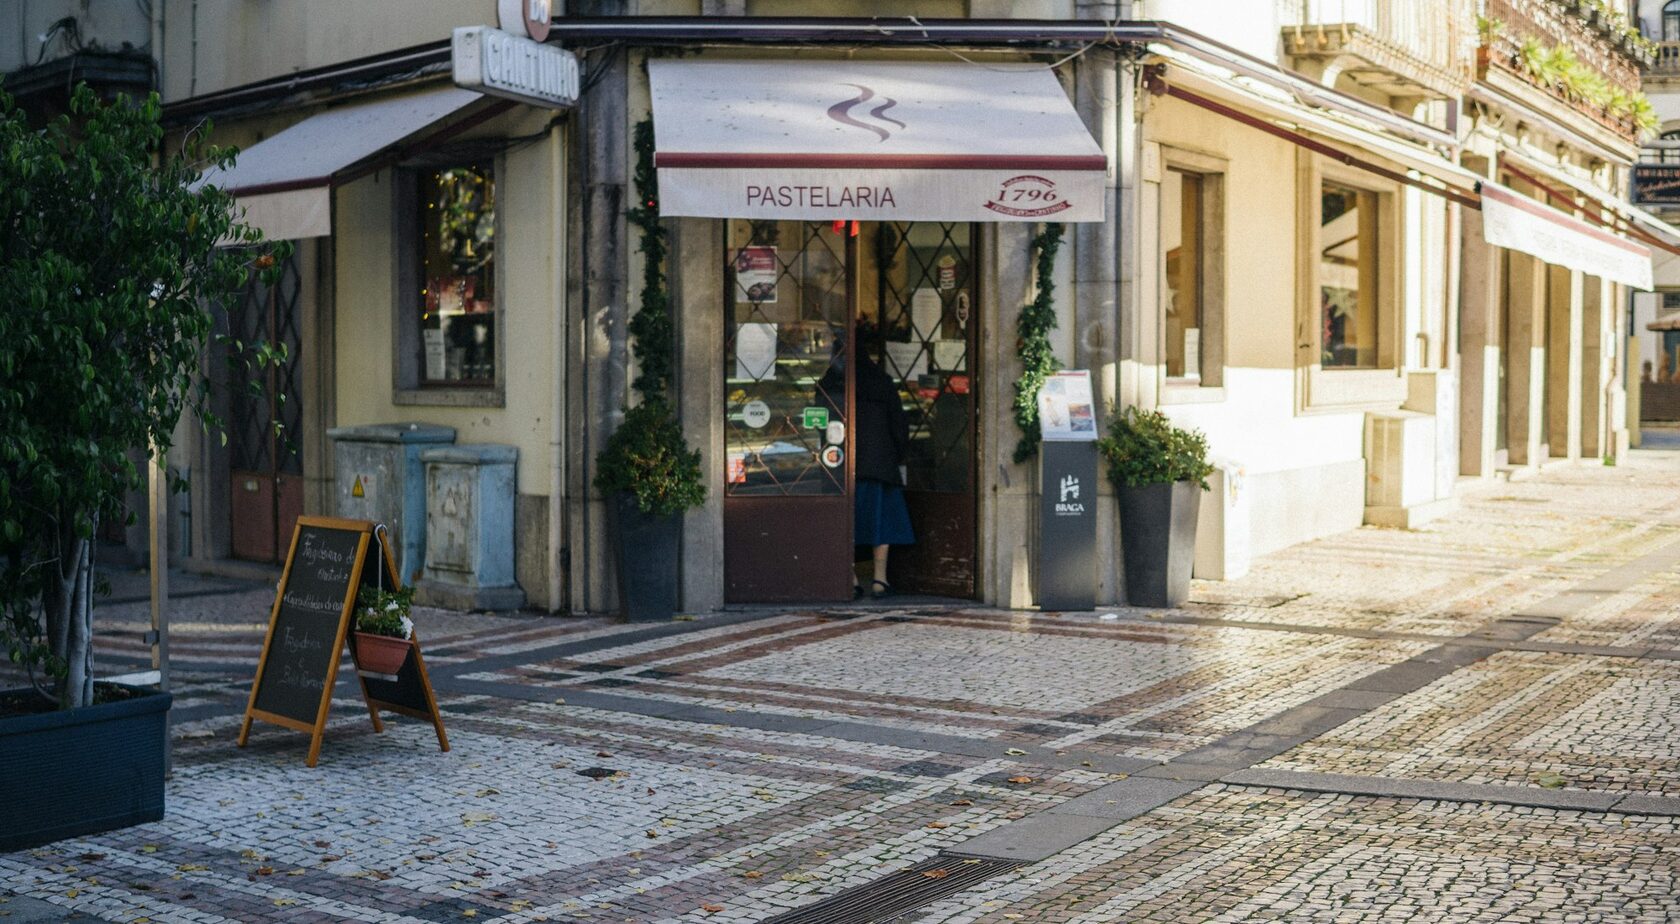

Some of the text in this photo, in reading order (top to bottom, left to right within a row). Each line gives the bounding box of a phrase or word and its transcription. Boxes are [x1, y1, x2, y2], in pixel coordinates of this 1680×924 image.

[747, 186, 897, 207] PASTELARIA
[997, 189, 1057, 202] 1796
[1055, 503, 1085, 512] BRAGA
